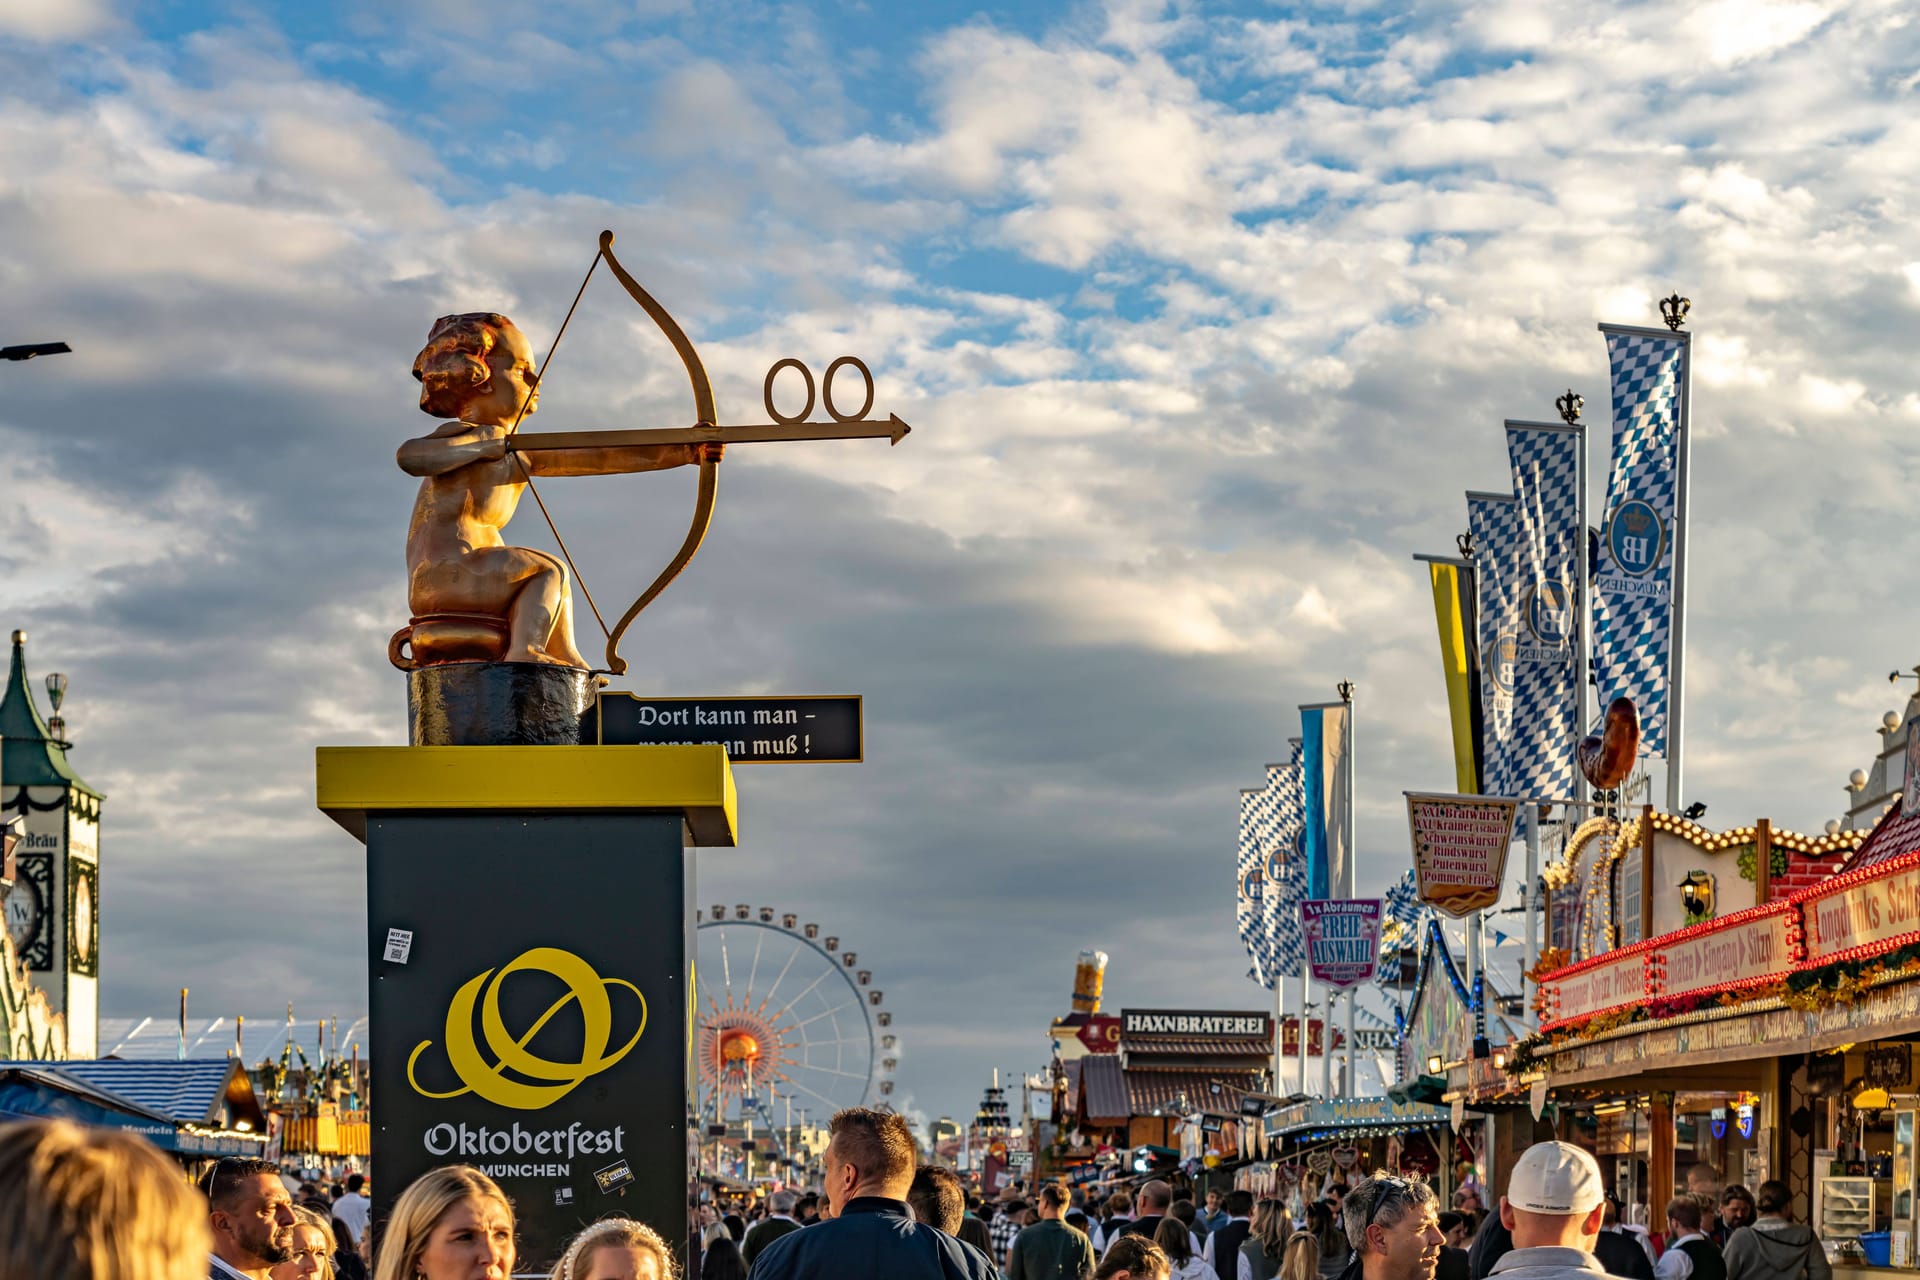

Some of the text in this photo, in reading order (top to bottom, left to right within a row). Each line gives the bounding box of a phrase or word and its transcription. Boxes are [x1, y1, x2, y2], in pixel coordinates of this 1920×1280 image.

[638, 705, 689, 727] Dort
[695, 706, 746, 726] kann
[753, 708, 798, 725] man
[1445, 808, 1502, 822] Bratwurst
[1436, 820, 1474, 833] Krainer
[1434, 846, 1488, 859] Rindswurst
[1432, 858, 1488, 872] Putenwurst
[1424, 870, 1495, 886] Pommes Frites
[1320, 914, 1362, 938] FREIE
[1815, 889, 1880, 949] Longdrinks
[1312, 940, 1372, 964] AUSWAHL
[1703, 938, 1739, 982] Eingang
[1126, 1014, 1265, 1035] HAXNBRATEREI
[121, 1124, 174, 1136] Mandeln
[423, 1121, 625, 1160] Oktoberfest
[479, 1163, 570, 1178] MÜNCHEN
